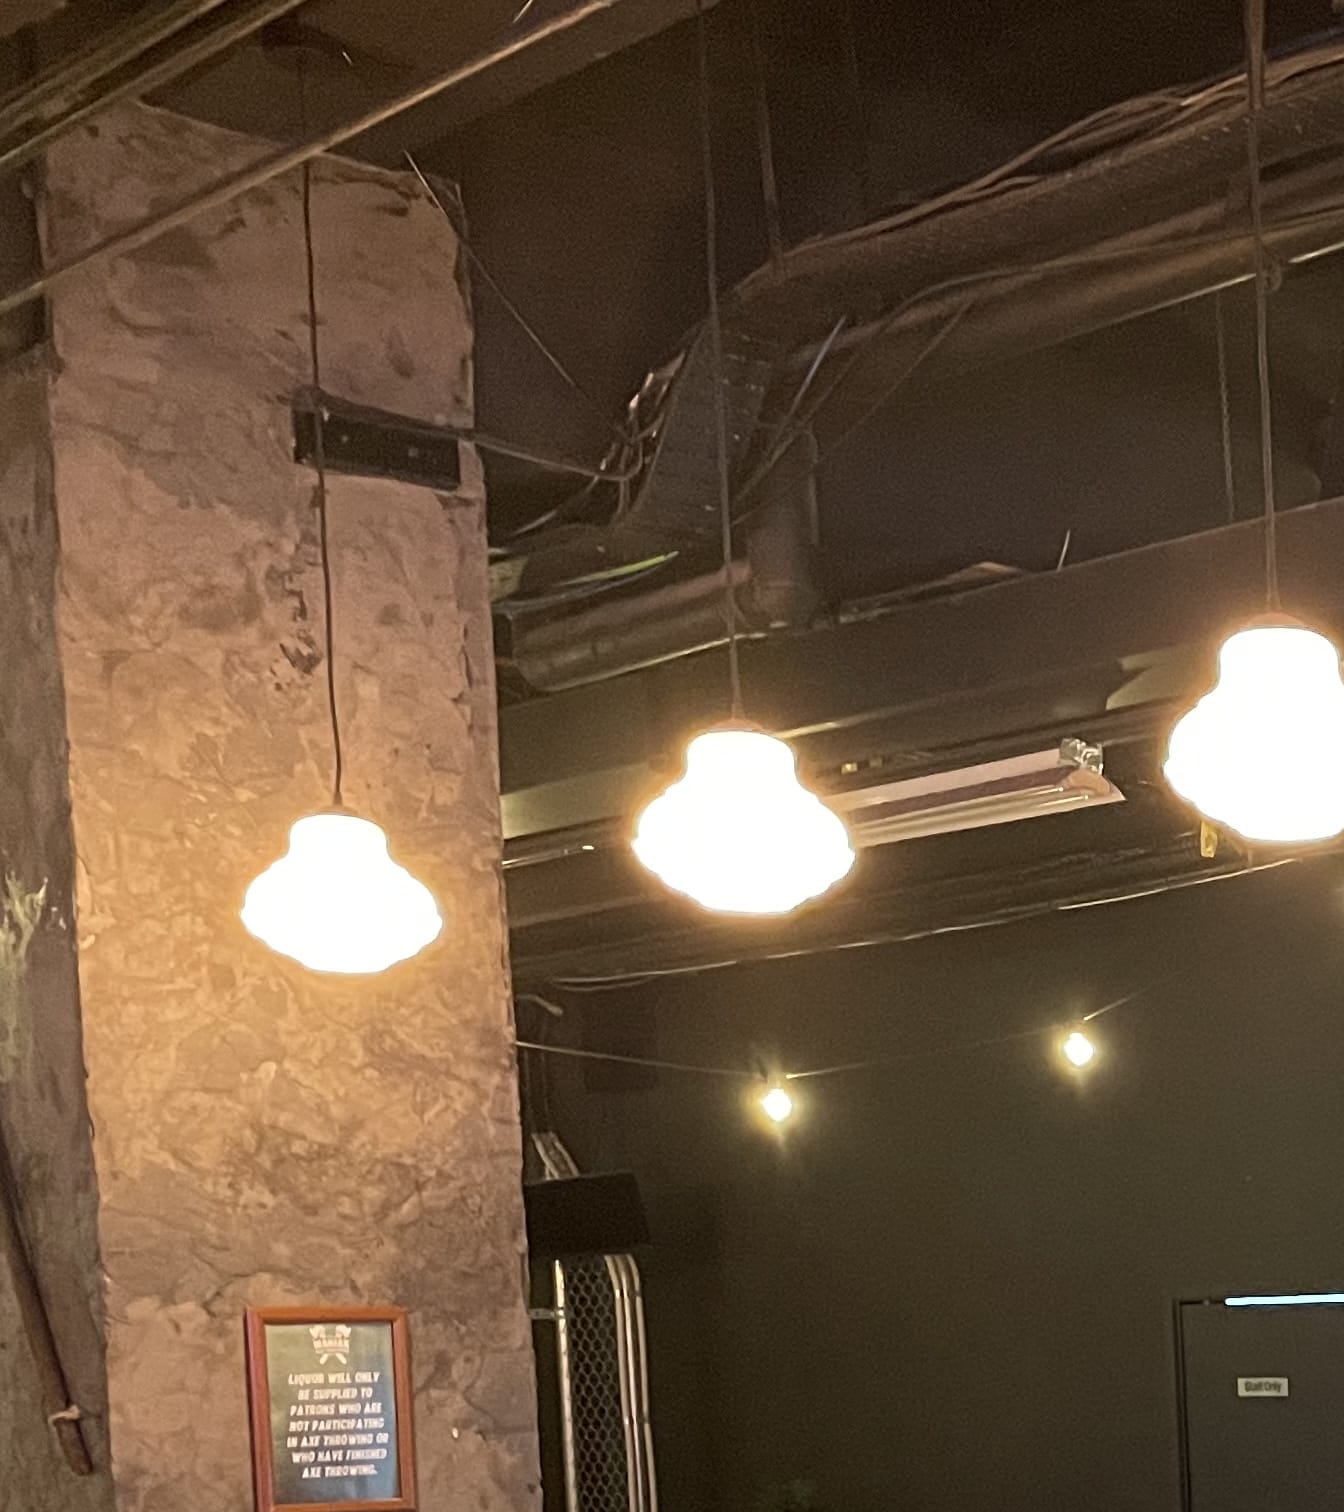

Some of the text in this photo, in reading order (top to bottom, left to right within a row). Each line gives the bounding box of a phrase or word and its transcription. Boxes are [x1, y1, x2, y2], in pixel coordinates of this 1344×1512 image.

[288, 1372, 380, 1386] LIQUOR WILL ONLY
[298, 1387, 373, 1400] BE SUPPLIED TO
[290, 1402, 382, 1416] PATRONS WHO ARE
[289, 1418, 384, 1432] NOT PARTICIPATING
[287, 1433, 389, 1448] IN AXE THROWING OR
[292, 1449, 387, 1463] WHO HAVE FINISHED
[302, 1467, 321, 1478] AXE
